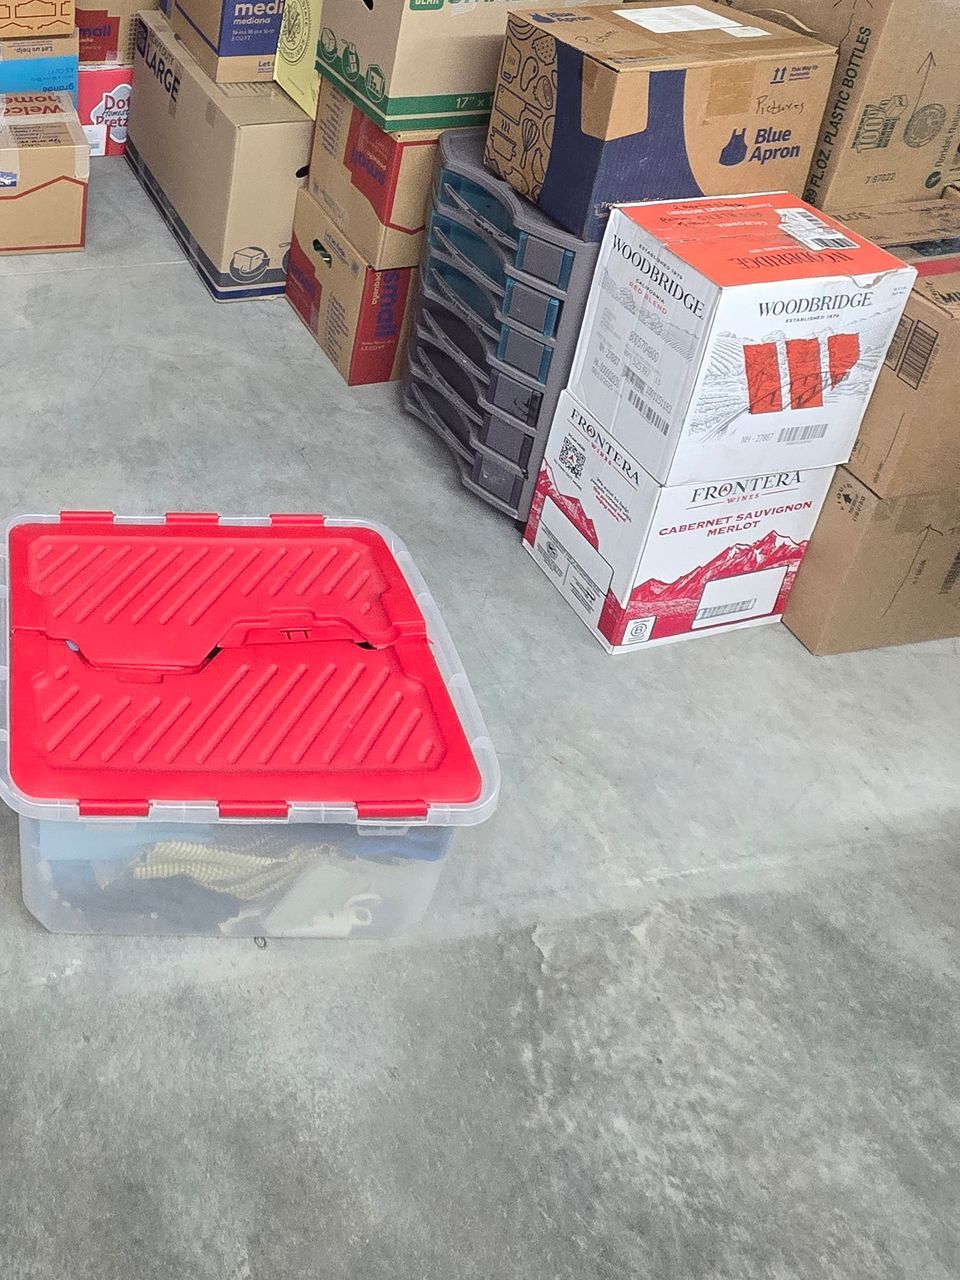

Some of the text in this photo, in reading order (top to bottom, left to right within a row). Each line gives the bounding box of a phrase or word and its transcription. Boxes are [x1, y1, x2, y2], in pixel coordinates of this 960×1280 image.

[233, 17, 271, 25] mediana
[144, 43, 181, 103] LARGE
[259, 60, 270, 68] Let
[825, 26, 872, 145] PLASTIC BOTTLES
[754, 127, 792, 145] Blue
[749, 145, 801, 163] Apron
[611, 234, 705, 321] WOODBRIDGE
[628, 281, 668, 316] RED BLEND
[636, 278, 665, 303] CALIFORNIA
[374, 271, 401, 337] small
[758, 292, 873, 316] WOODBRIDGE
[785, 315, 826, 324] ESTABLISHED
[570, 409, 640, 486] FRONTERA
[590, 442, 612, 466] WINES
[691, 471, 805, 503] FRONTERA
[727, 493, 760, 504] WINES
[659, 501, 813, 537] CABERNET SAUVIGNON
[707, 521, 760, 537] MERLOT
